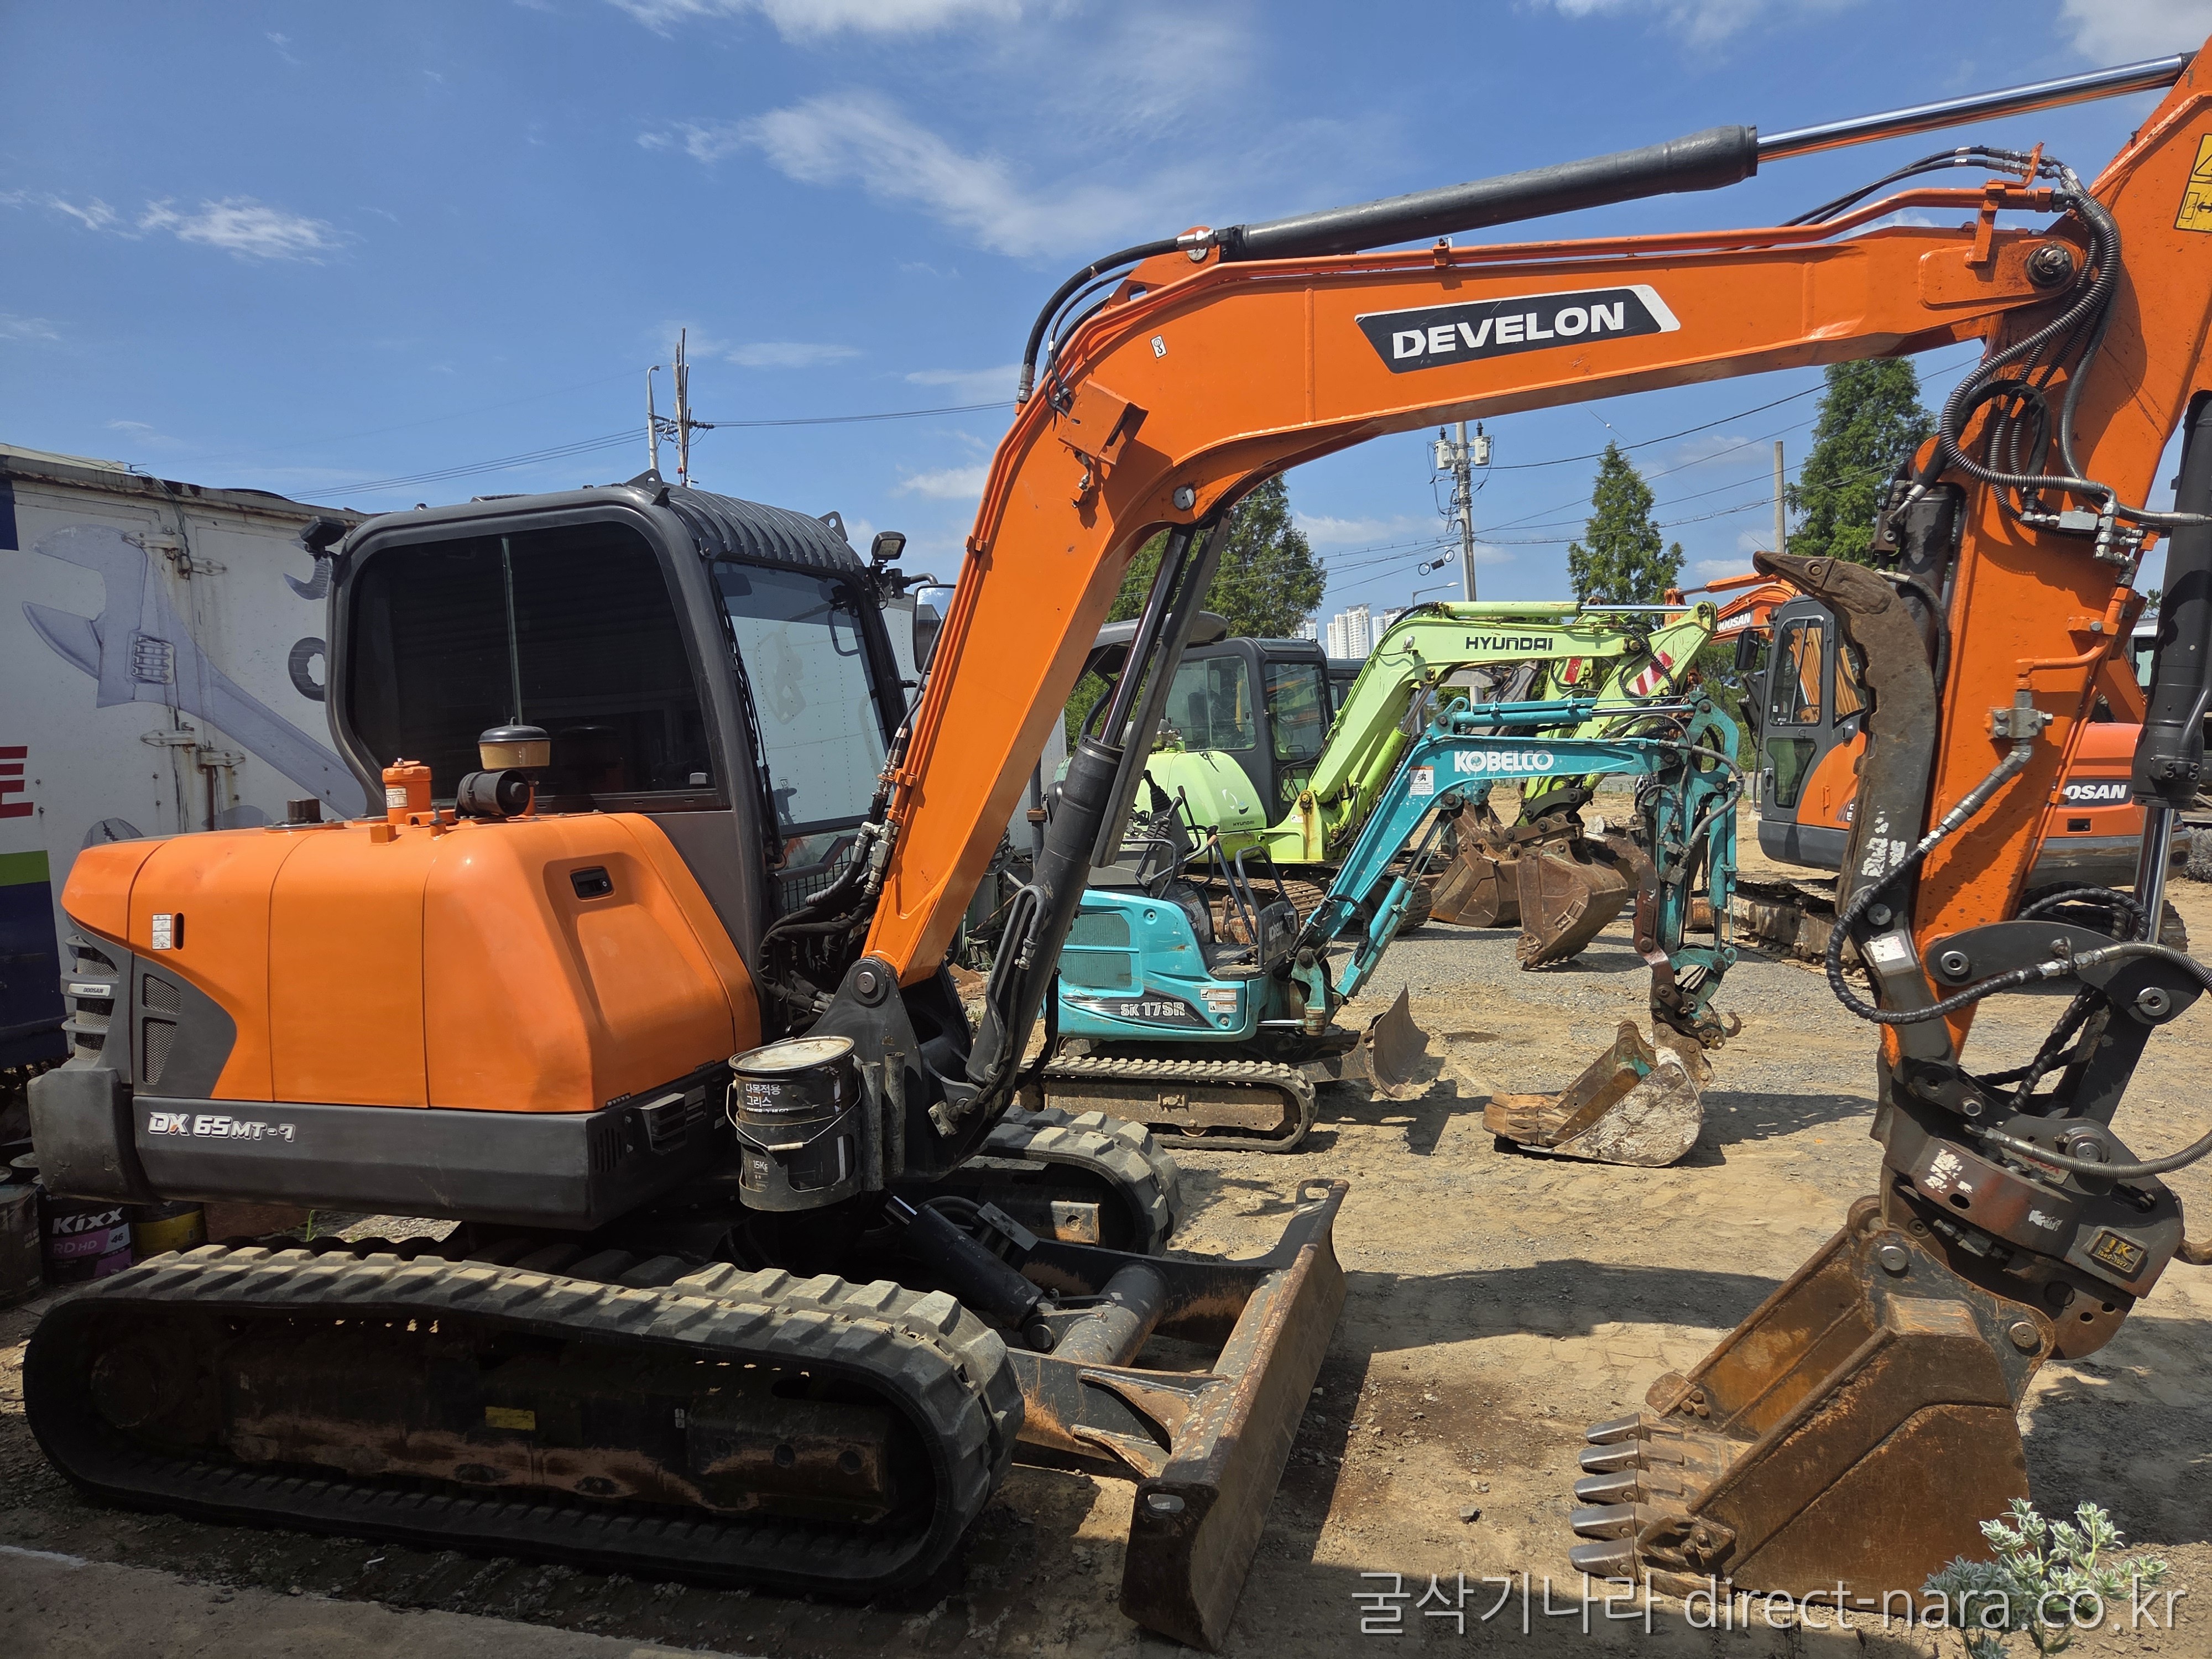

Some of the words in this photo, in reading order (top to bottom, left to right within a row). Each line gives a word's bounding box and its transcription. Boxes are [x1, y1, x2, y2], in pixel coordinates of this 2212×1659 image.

[1393, 302, 1624, 359] DEVELON
[1465, 637, 1553, 651] HYUNDAI
[1454, 749, 1553, 772] KOBELCO
[2054, 785, 2127, 800] OSAN
[745, 1083, 781, 1095] 다목적용
[747, 1095, 773, 1107] 그리스
[52, 1207, 123, 1234] Kixx
[111, 1233, 123, 1243] 46
[54, 1241, 75, 1254] RD
[79, 1240, 97, 1251] HD
